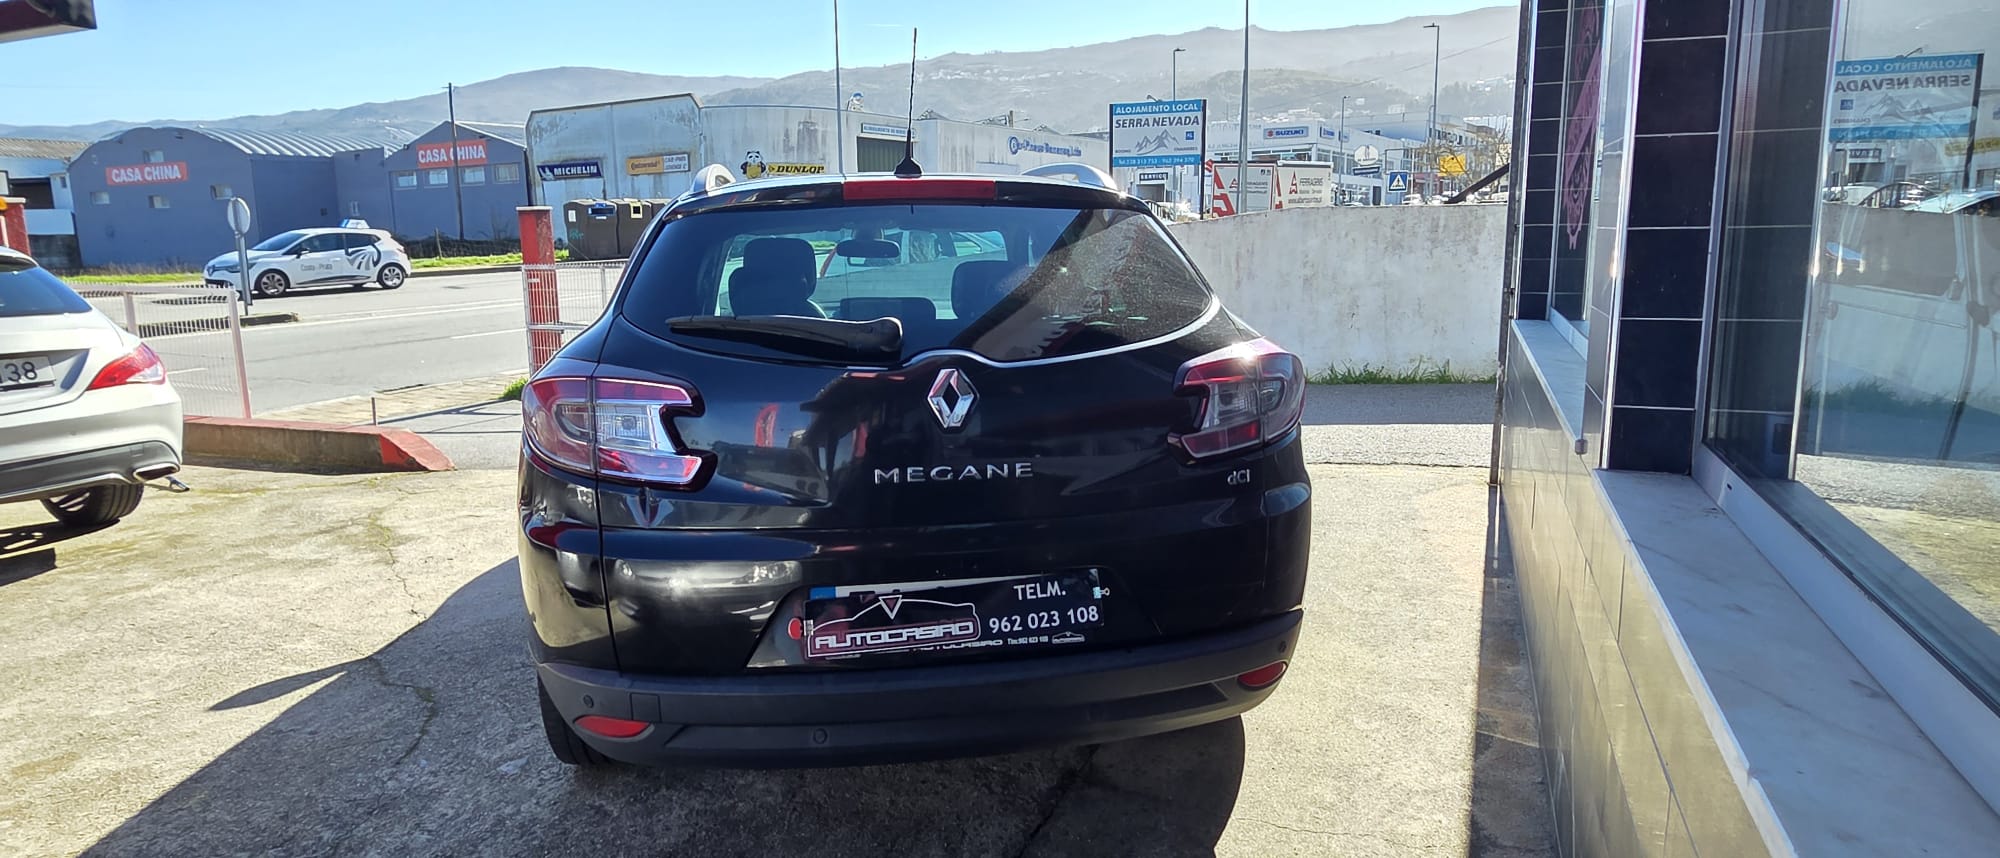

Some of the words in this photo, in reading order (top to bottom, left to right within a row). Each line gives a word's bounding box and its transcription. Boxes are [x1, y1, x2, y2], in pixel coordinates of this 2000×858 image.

[1115, 104, 1170, 114] ALOJAMENTO
[1172, 103, 1198, 111] LOCAL
[1115, 118, 1150, 129] SERRA
[1151, 115, 1200, 127] NEVADA
[418, 148, 447, 163] CASA
[111, 167, 142, 183] CASA
[144, 165, 181, 181] CHINA
[554, 165, 598, 176] MICHELIN
[776, 165, 825, 173] DUNLOP
[0, 361, 37, 384] 38
[874, 462, 1034, 484] MEGANE
[1013, 581, 1066, 600] TELM.
[989, 615, 1022, 633] 962
[1027, 611, 1060, 629] 023
[1067, 606, 1099, 624] 108
